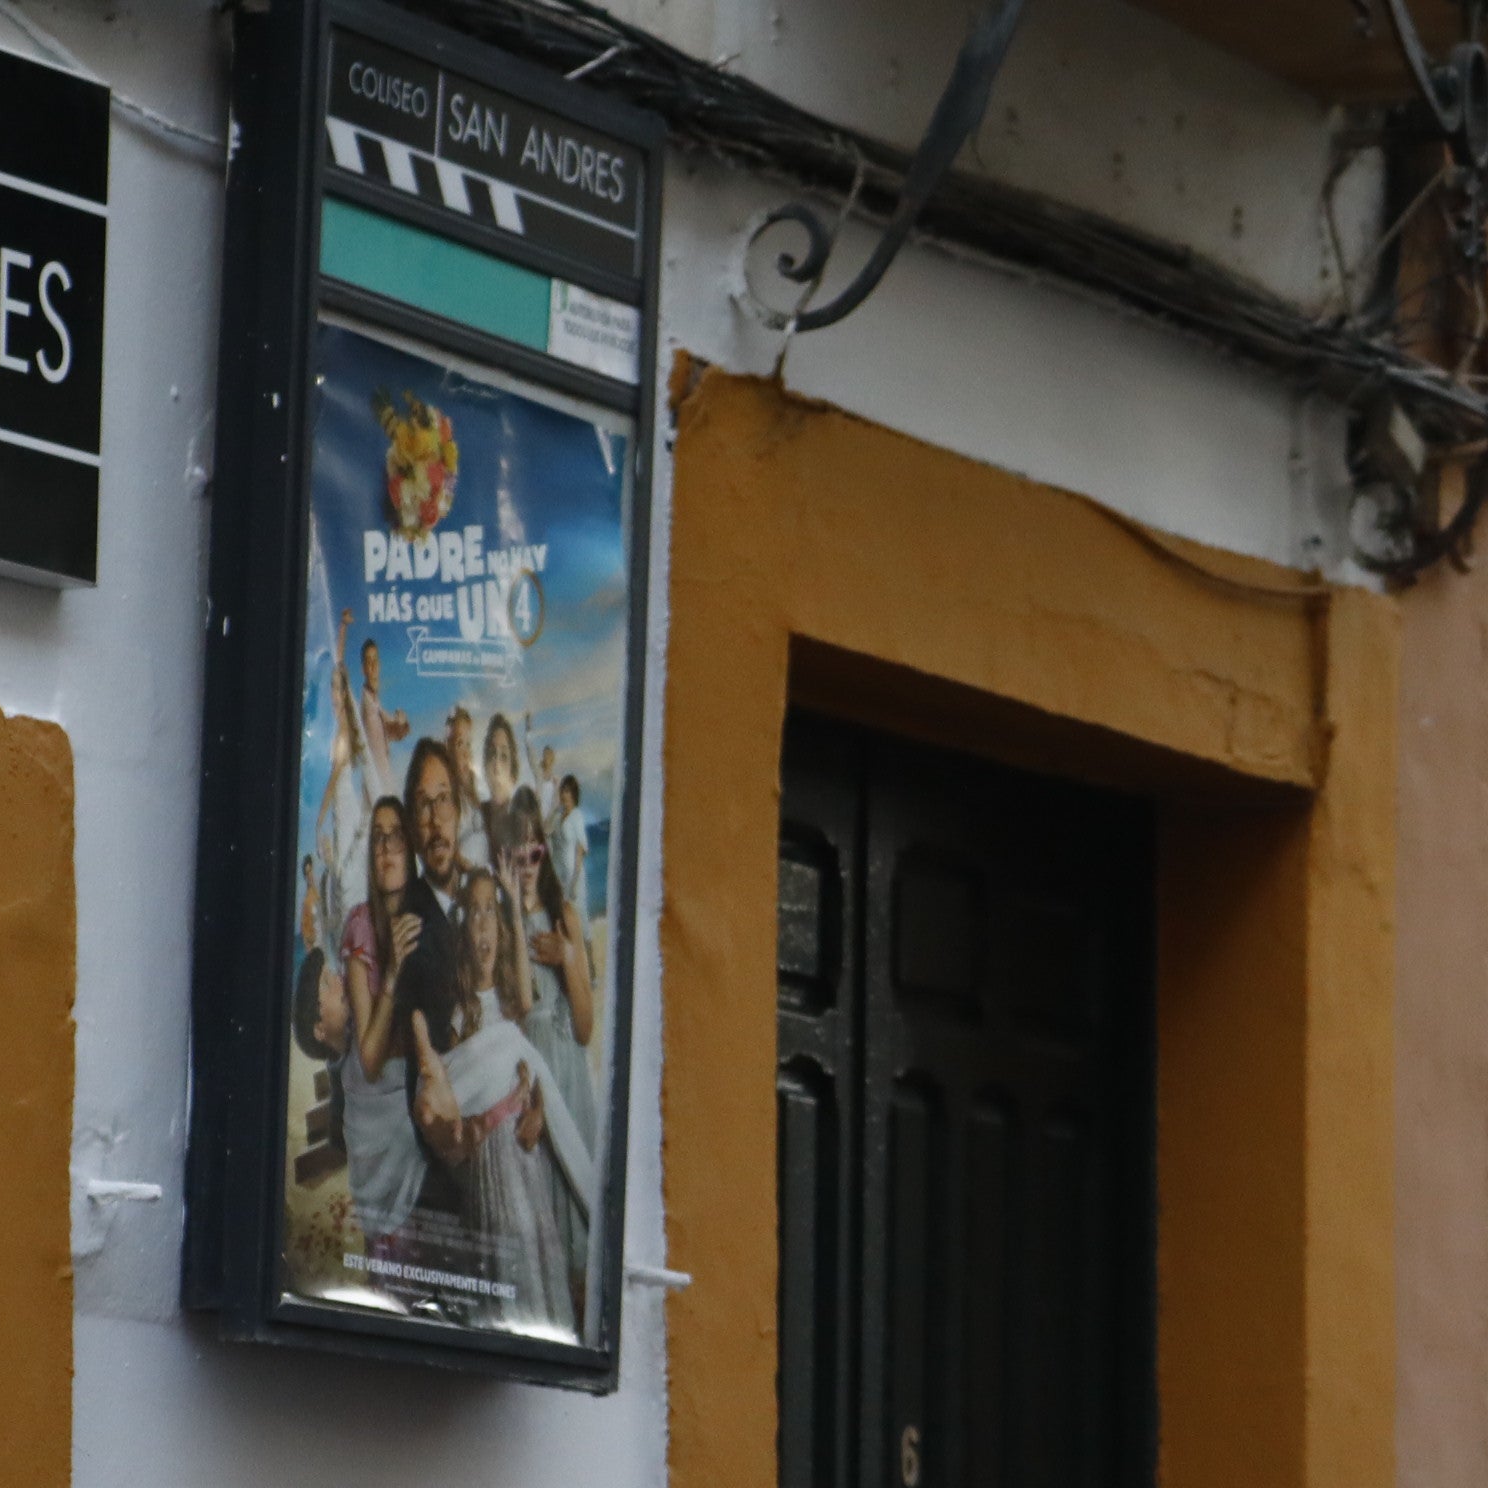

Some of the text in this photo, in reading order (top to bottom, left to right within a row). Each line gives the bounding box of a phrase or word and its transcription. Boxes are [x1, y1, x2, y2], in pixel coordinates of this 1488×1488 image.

[348, 62, 429, 118] COLISEO
[448, 92, 626, 203] SAN ANDRES
[364, 525, 484, 583] PADRE
[368, 585, 412, 623] MÁS
[415, 594, 455, 621] QUE
[343, 1252, 364, 1271] ESTE
[366, 1257, 403, 1277] VERANO
[403, 1265, 479, 1292] EXCLUSIVAMENTE
[479, 1278, 491, 1295] EN
[491, 1281, 517, 1300] CINES
[901, 1425, 920, 1488] 6
